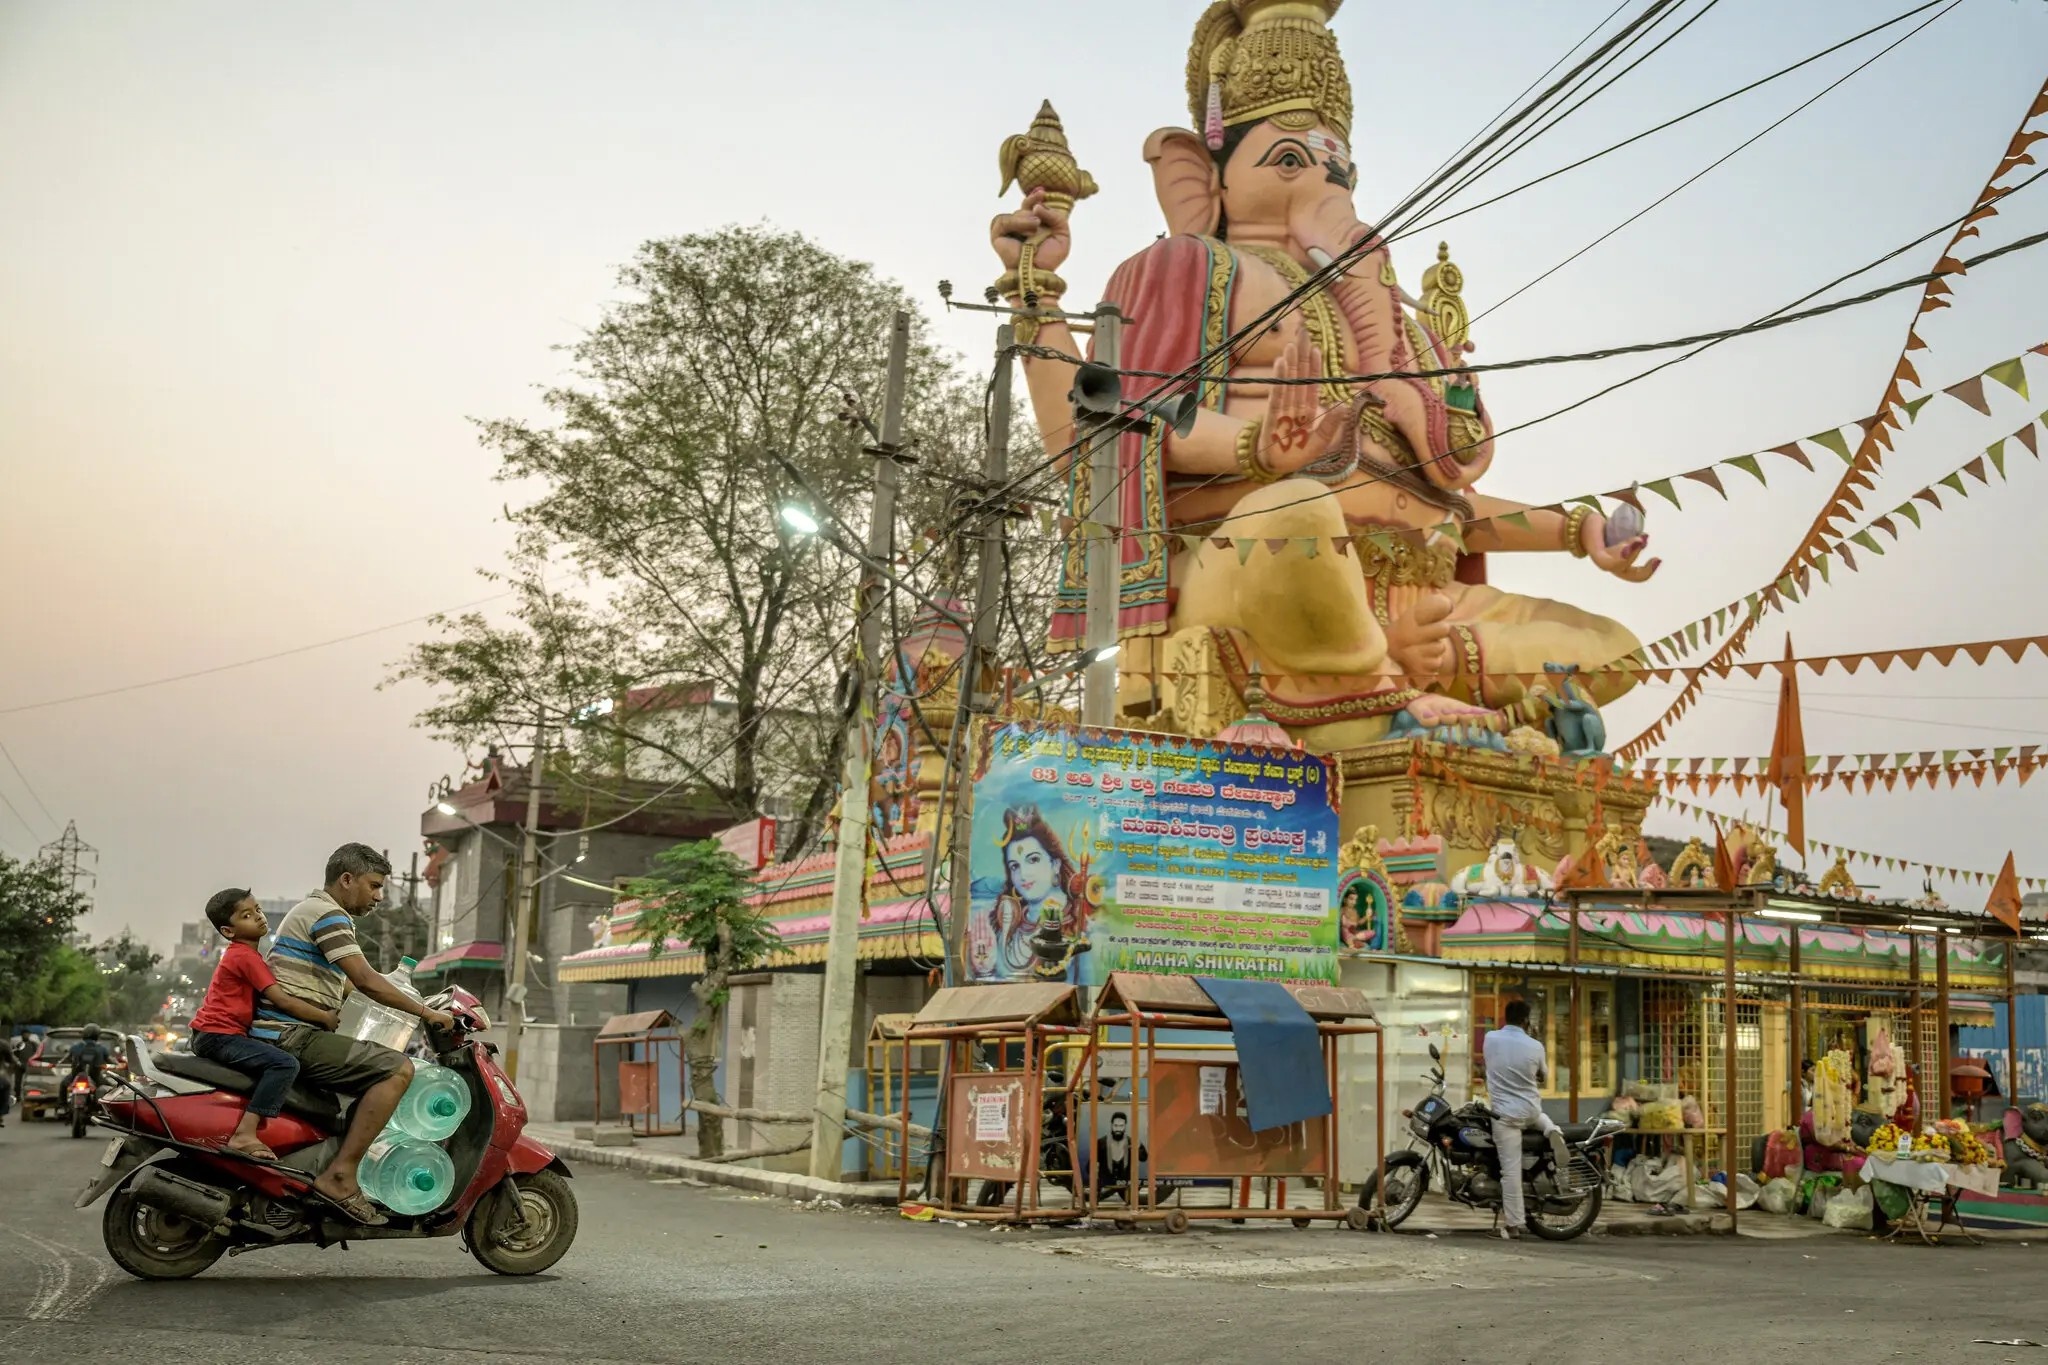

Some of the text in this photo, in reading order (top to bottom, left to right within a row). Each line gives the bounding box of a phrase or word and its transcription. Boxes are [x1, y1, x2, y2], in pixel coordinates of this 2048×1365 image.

[1031, 767, 1058, 782] 63
[1065, 771, 1094, 786] ಅಡಿ
[1099, 772, 1123, 793] ಶ್ರೀ
[1129, 777, 1157, 797] ಶಕ್ತಿ
[1162, 780, 1215, 798] ಗಣಪತಿ
[1121, 817, 1236, 847] ಮಹಾಶಿವರಾತ್ರಿ
[1244, 826, 1307, 855] ಪ್ರಯುಕ್ತ
[1136, 951, 1285, 972] MAHA SHIVRATRI
